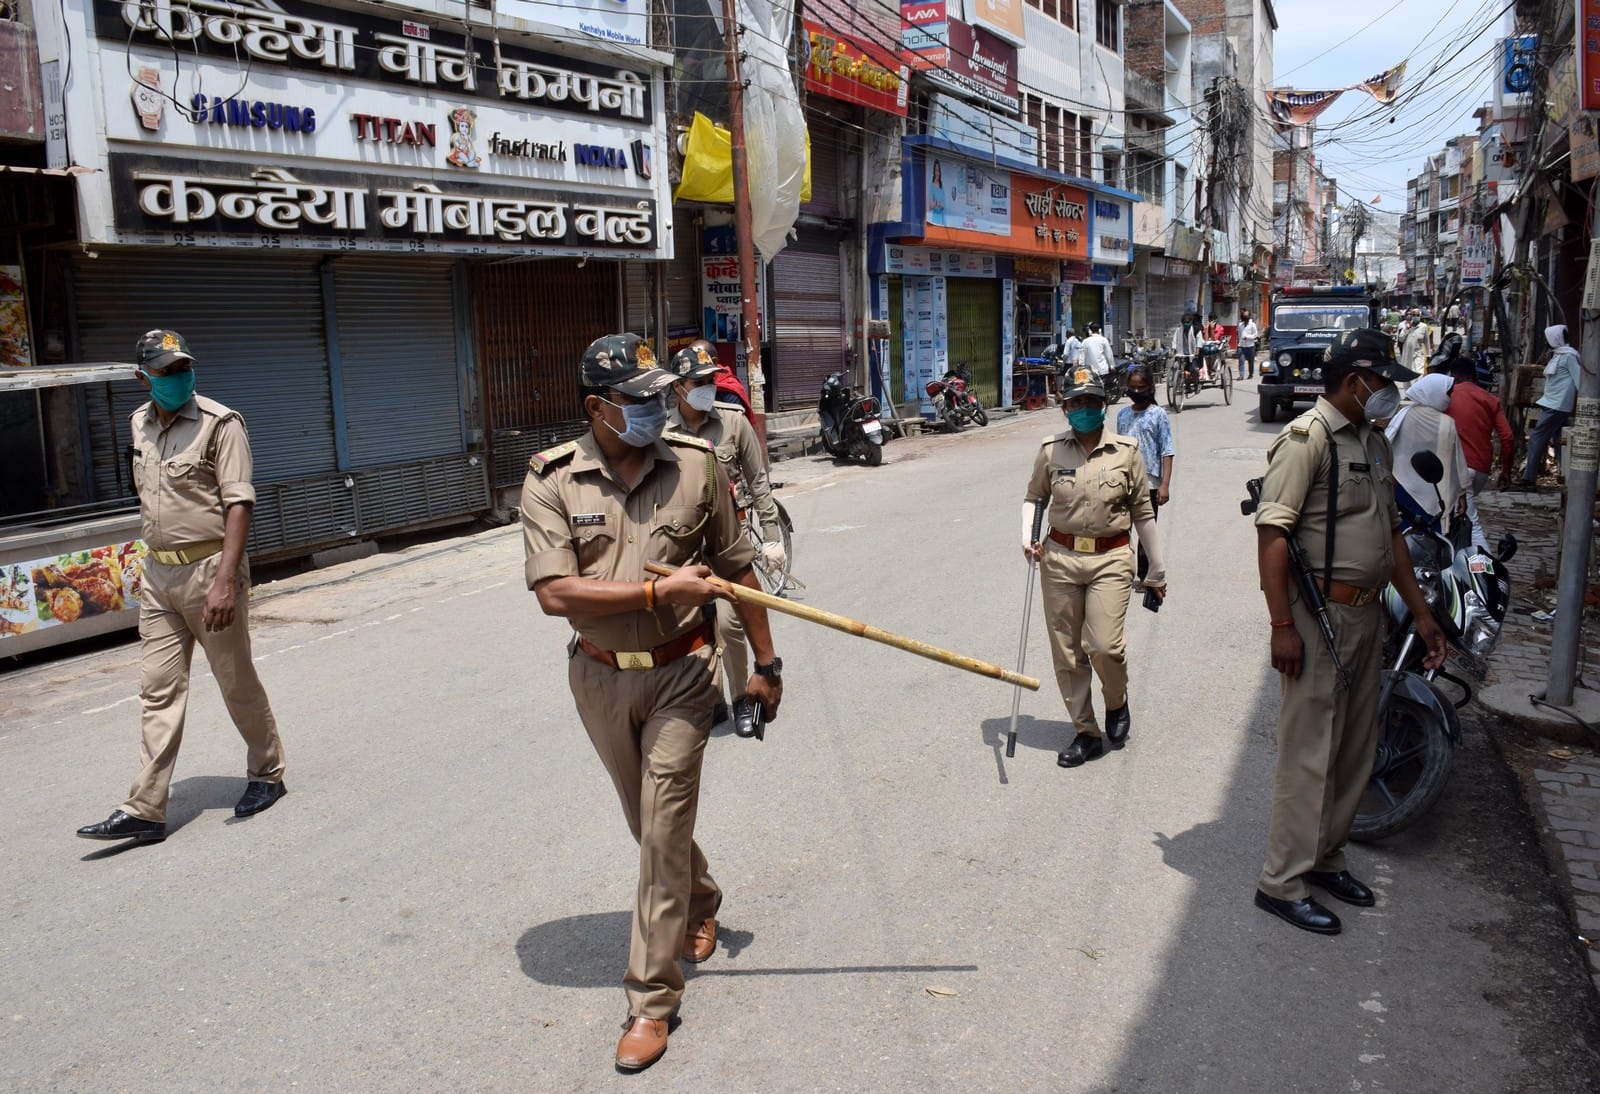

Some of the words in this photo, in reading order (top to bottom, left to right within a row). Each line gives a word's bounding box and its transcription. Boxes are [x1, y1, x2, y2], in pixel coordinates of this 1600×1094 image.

[907, 8, 939, 20] LAVA
[902, 31, 945, 45] honor
[192, 93, 316, 133] SAMSUNG
[351, 113, 436, 147] TITAN
[489, 132, 567, 162] fastrack
[574, 143, 628, 169] NOKIA
[133, 167, 368, 229] कन्हैया
[377, 183, 569, 240] मोबाइल
[575, 201, 652, 244] वर्ल्ड
[1025, 189, 1053, 219] साड़ी
